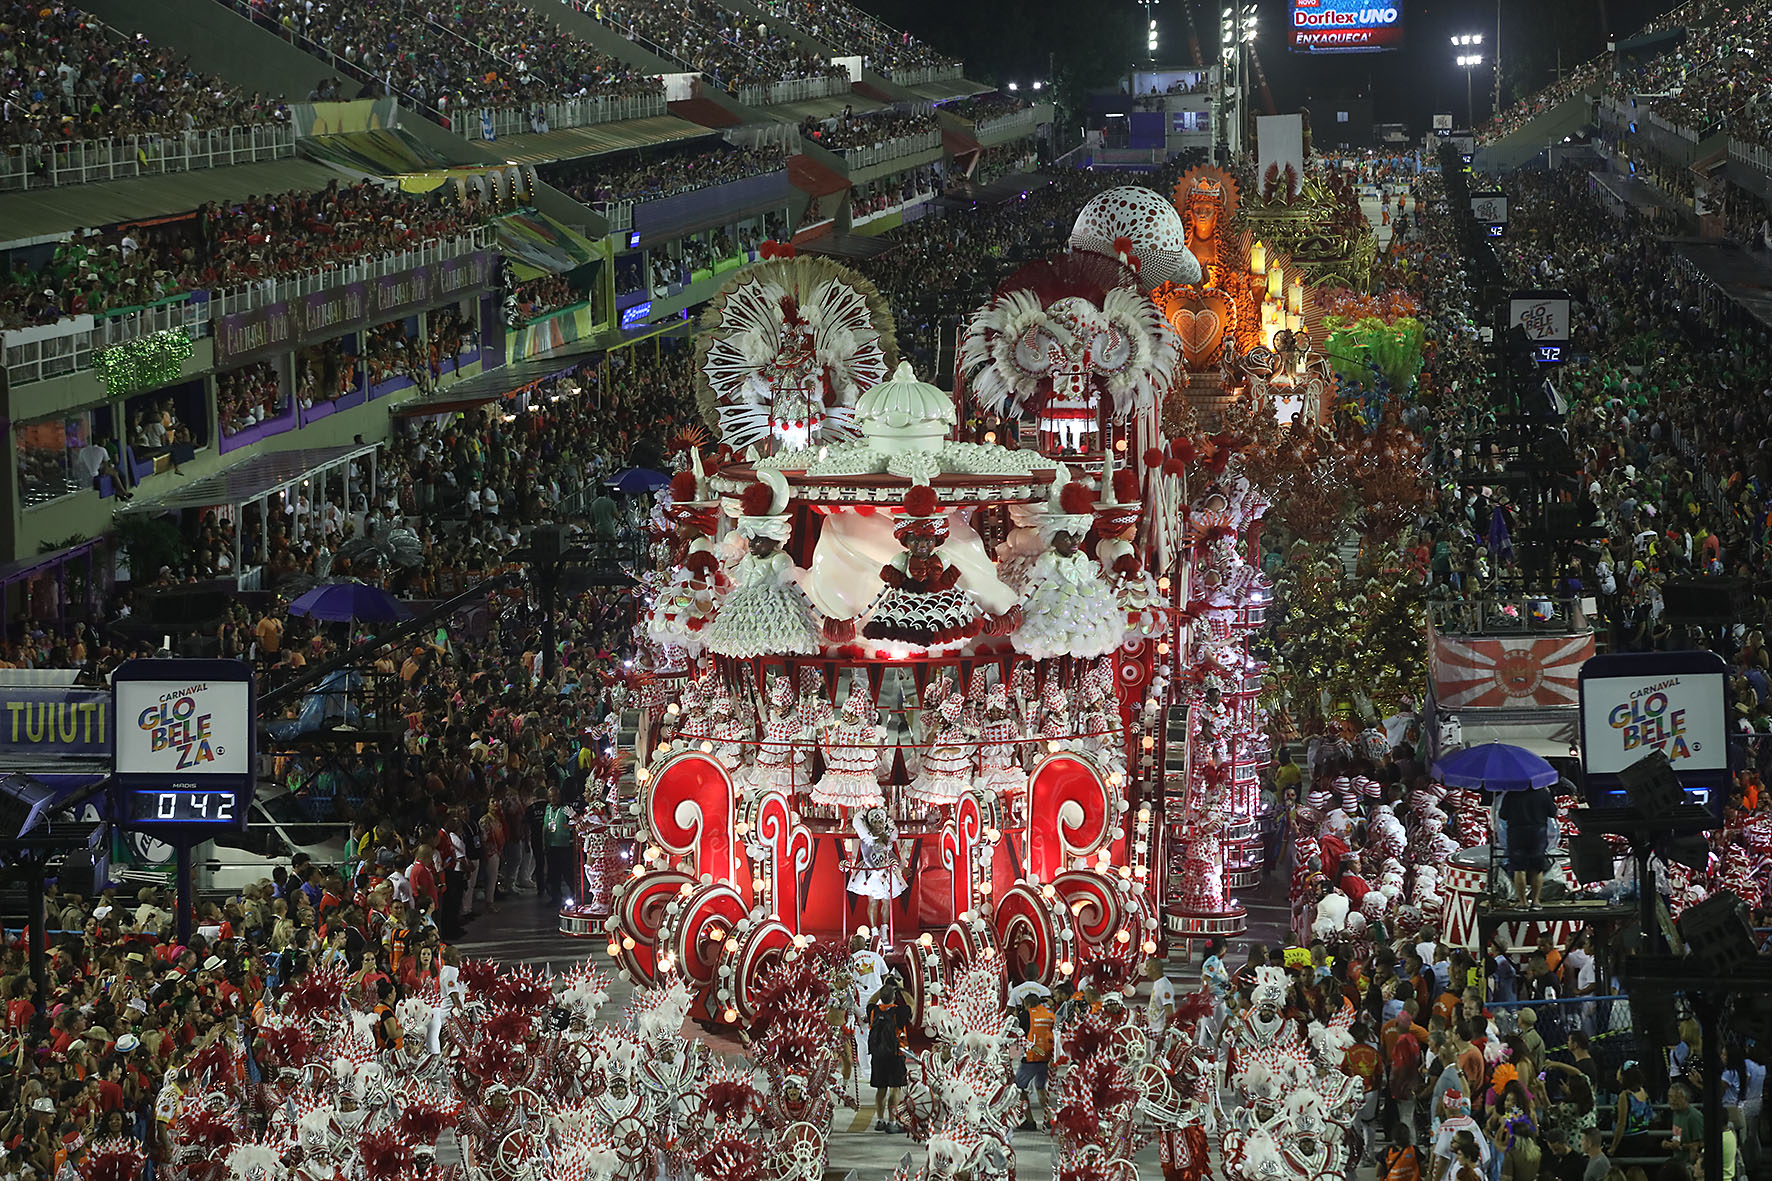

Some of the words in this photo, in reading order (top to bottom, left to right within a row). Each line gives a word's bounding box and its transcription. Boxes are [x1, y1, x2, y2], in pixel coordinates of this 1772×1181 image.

[1295, 10, 1356, 25] Dorflex
[1359, 8, 1398, 23] UNO
[1490, 227, 1503, 236] 42
[1520, 306, 1545, 321] GLO
[1526, 314, 1552, 329] BELE
[1537, 325, 1553, 338] ZA
[1541, 348, 1560, 360] 42
[159, 683, 208, 702] CARNAVAL
[1630, 677, 1681, 699] CARNAVAL
[138, 697, 196, 730] GLO
[1608, 692, 1668, 729] GLO
[7, 702, 105, 743] TUIUTI
[151, 713, 212, 752] BELE
[1623, 708, 1687, 751] BELE
[175, 739, 215, 770] ZA
